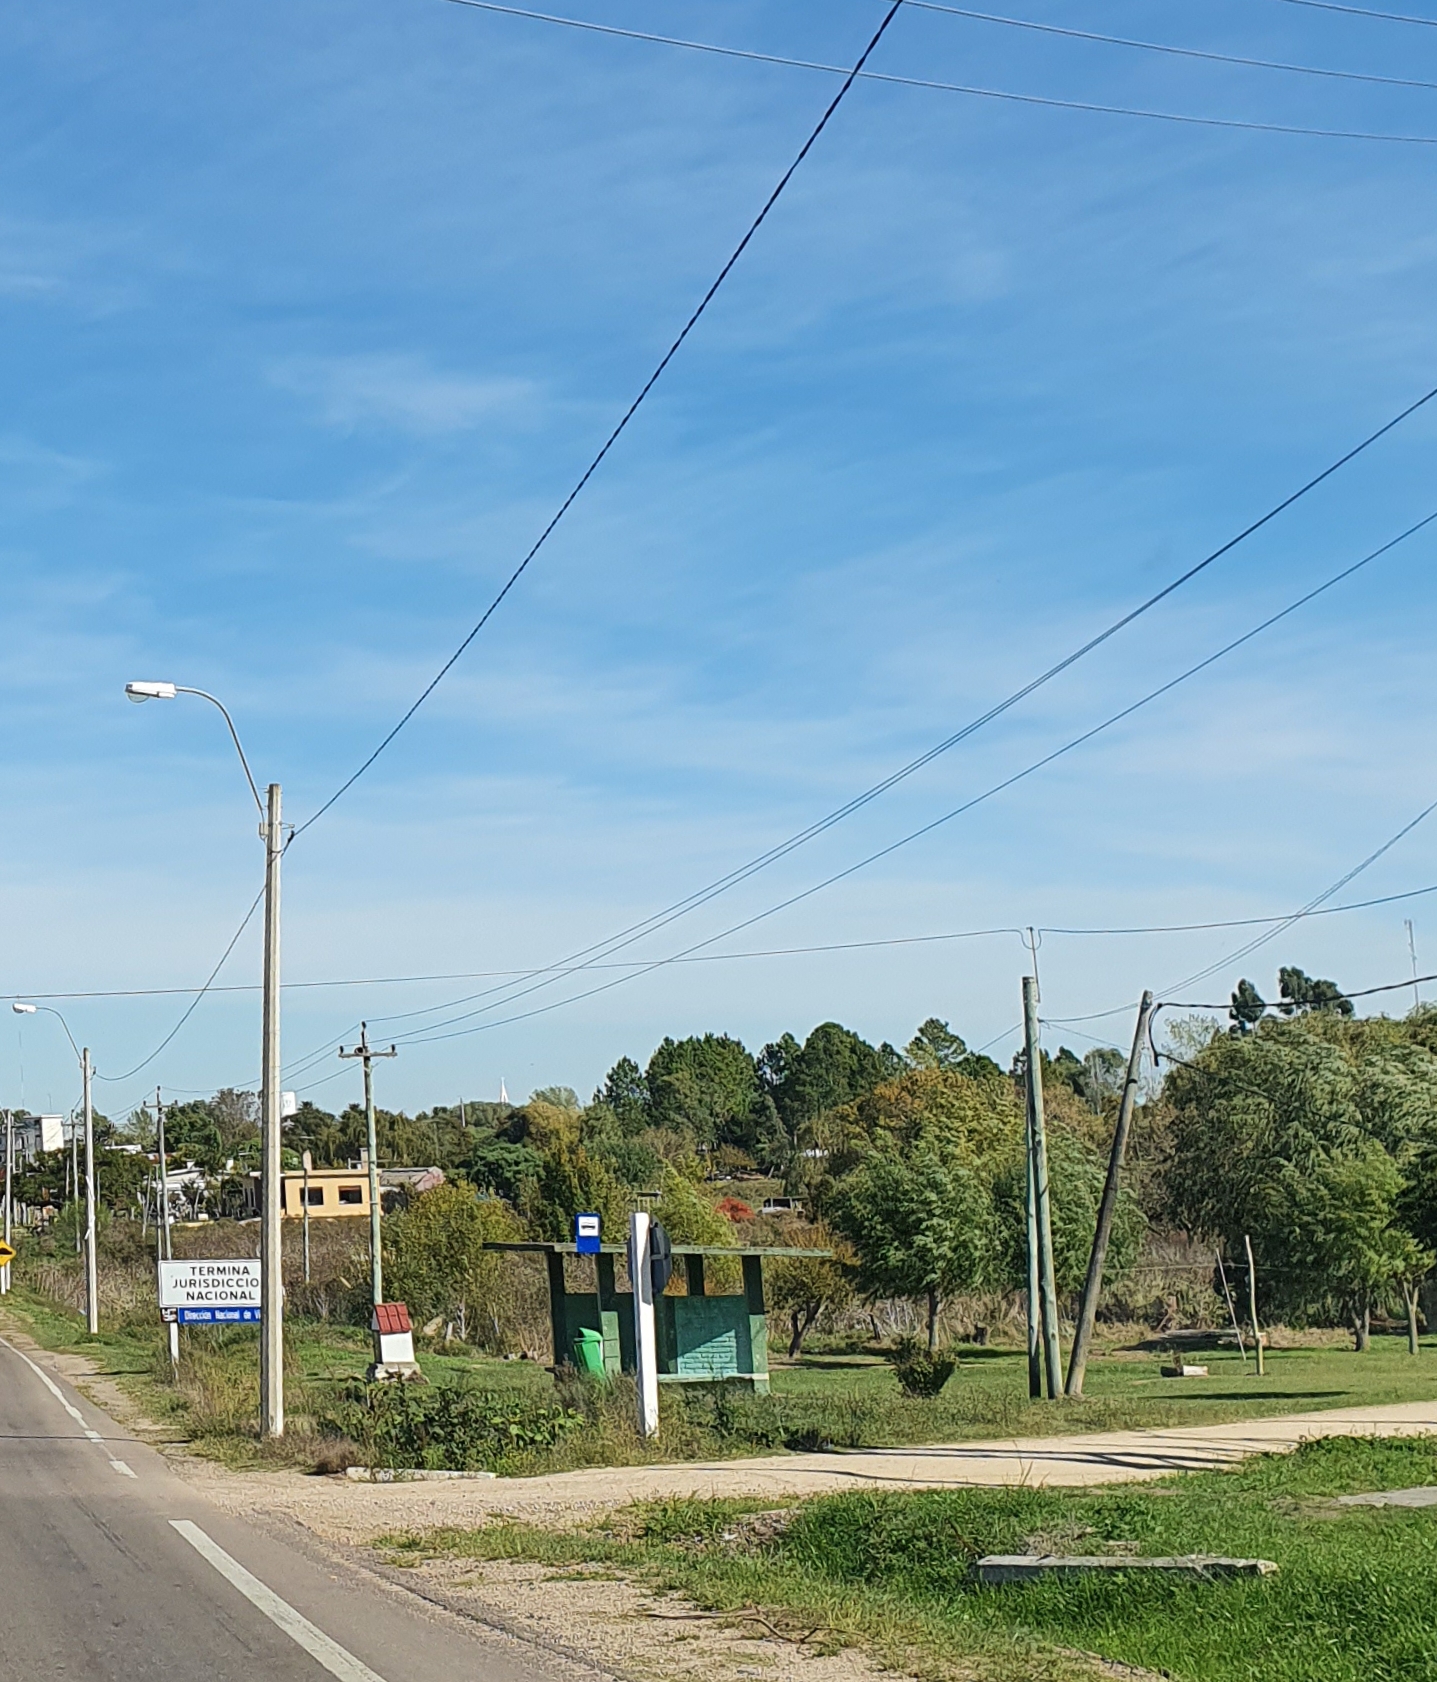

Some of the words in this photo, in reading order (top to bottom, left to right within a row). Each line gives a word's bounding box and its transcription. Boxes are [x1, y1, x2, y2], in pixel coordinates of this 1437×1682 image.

[189, 1266, 250, 1276] TERMINA
[172, 1278, 259, 1288] JURISDICCIO
[186, 1291, 256, 1301] NACIONAL
